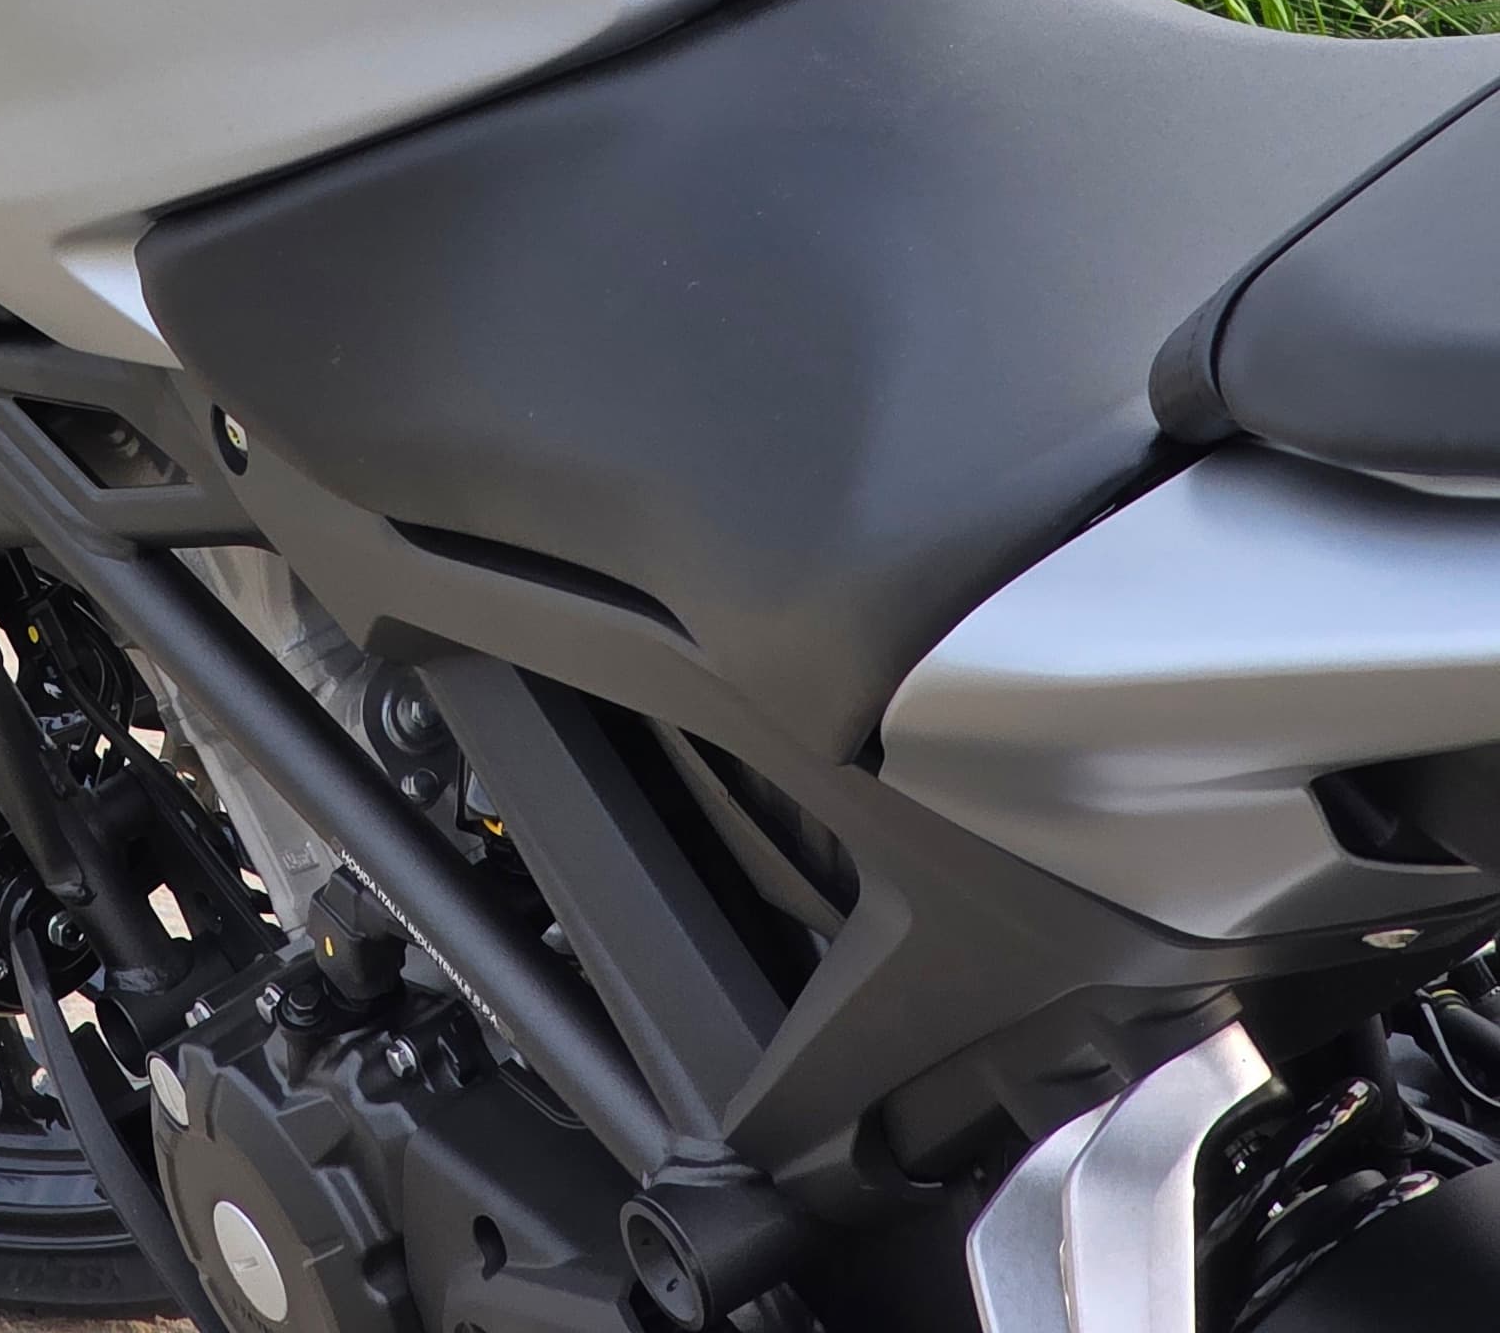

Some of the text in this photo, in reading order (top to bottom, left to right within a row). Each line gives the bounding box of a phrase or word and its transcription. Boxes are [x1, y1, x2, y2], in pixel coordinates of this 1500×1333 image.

[340, 850, 377, 895] HONDA
[375, 888, 407, 928] ITALIA
[406, 923, 475, 1002] INDUSTRIALE
